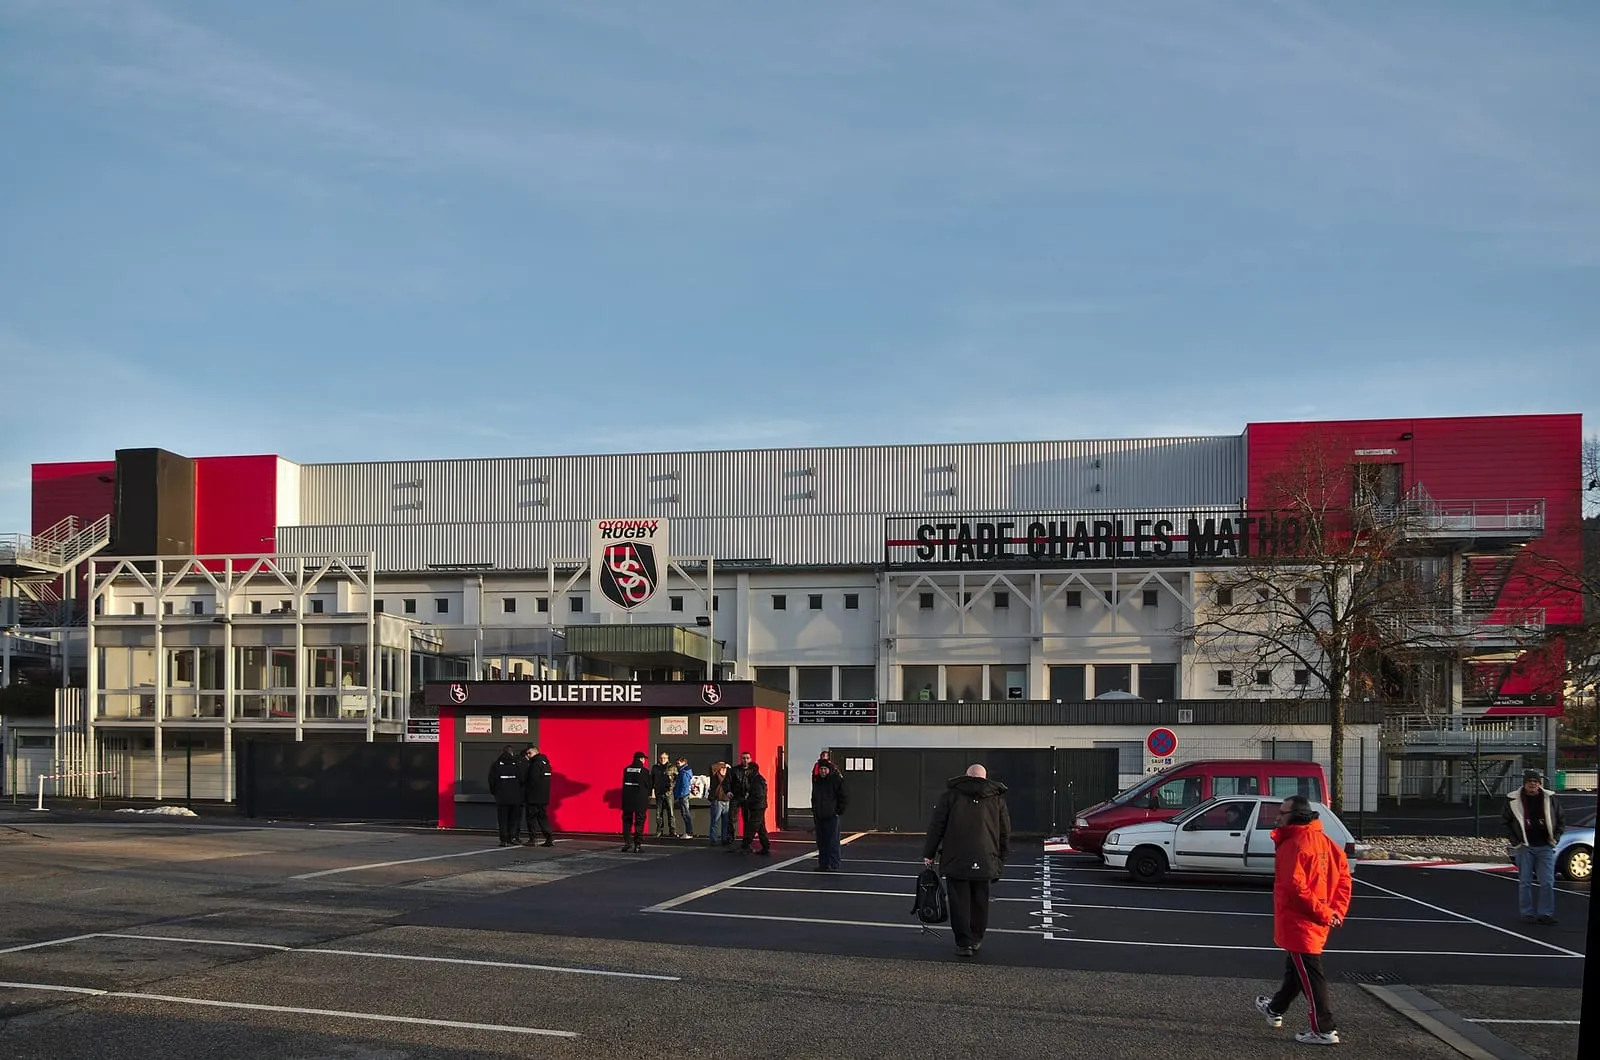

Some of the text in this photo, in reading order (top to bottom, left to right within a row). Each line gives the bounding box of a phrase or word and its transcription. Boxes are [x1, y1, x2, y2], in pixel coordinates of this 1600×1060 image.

[599, 520, 658, 529] OYONNAX
[602, 527, 658, 538] RUGBY
[917, 517, 1323, 560] STADE CHARLES MATHO
[530, 684, 642, 702] BILLETTERIE
